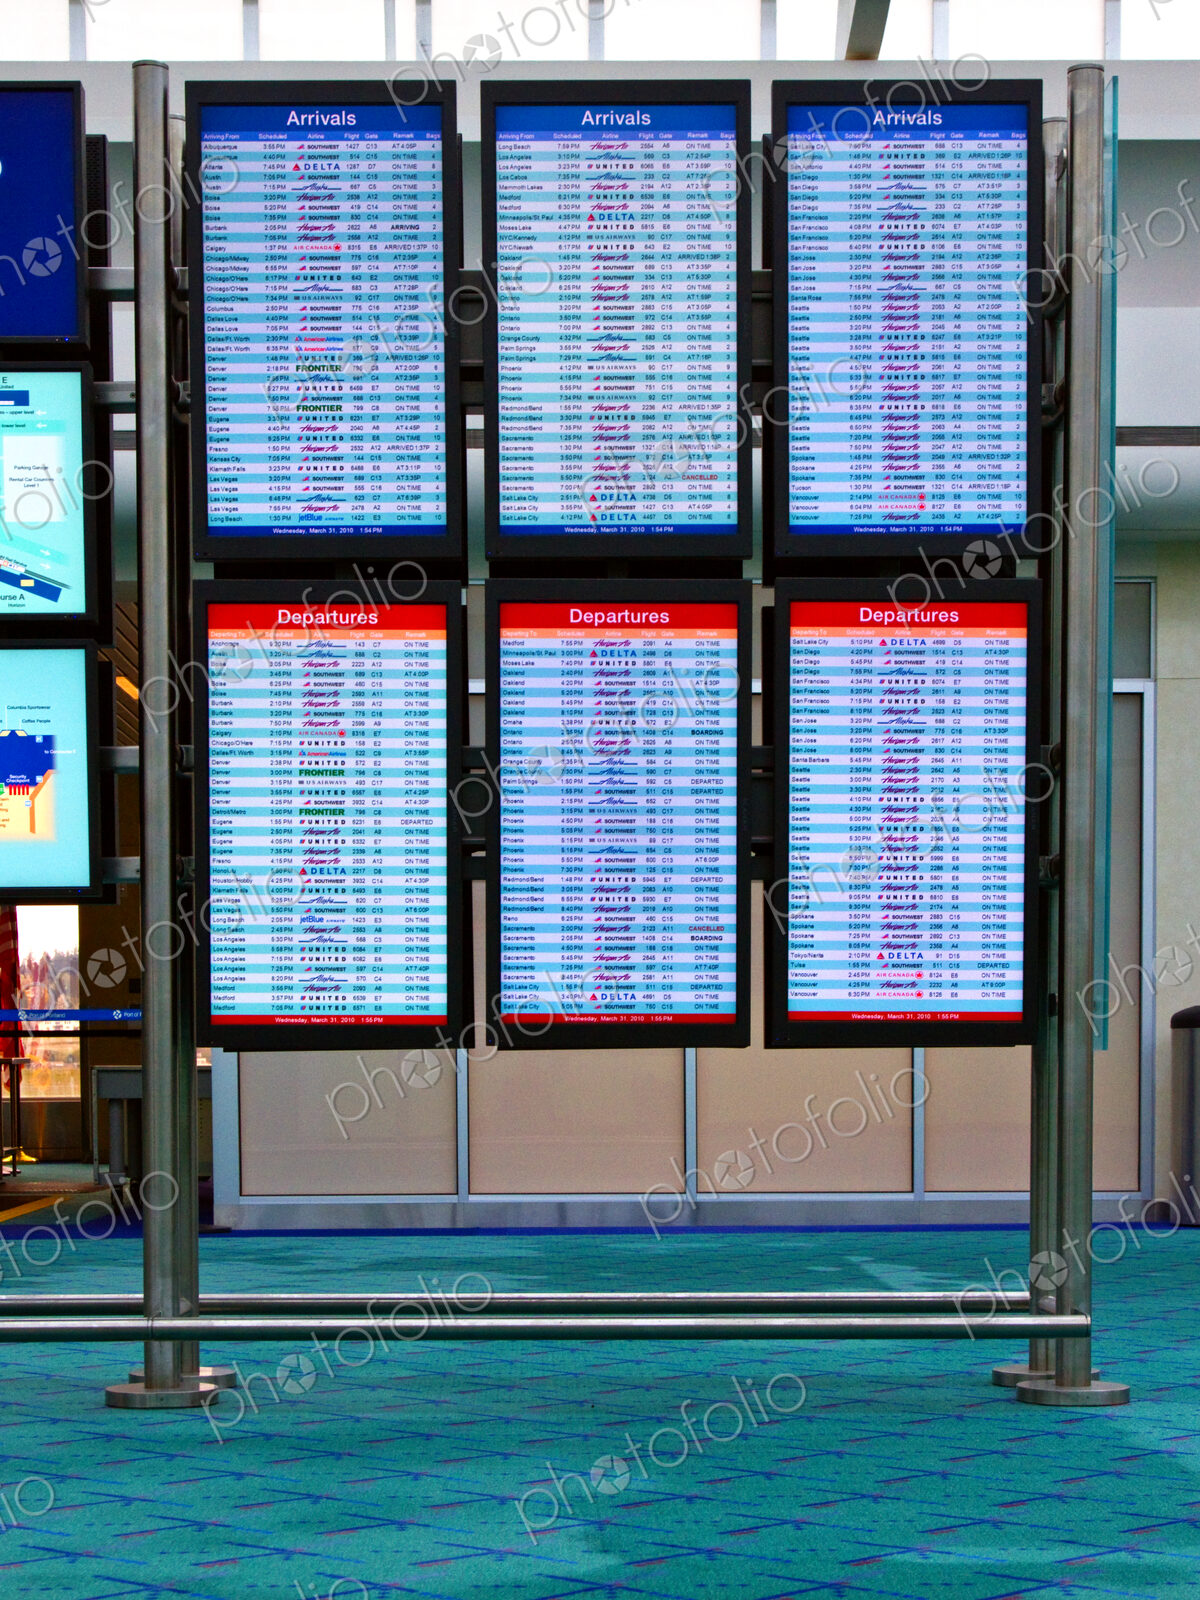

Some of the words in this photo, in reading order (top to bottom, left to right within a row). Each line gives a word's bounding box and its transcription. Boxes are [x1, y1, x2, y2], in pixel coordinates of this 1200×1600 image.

[287, 111, 356, 126] Arrivals
[581, 111, 651, 126] Arrivals
[873, 111, 942, 125] Arrivals
[304, 163, 341, 171] DELTA
[299, 513, 323, 522] jetBlue
[278, 610, 378, 627] Departures
[570, 609, 670, 626] Departures
[859, 608, 959, 625] Departures
[299, 808, 345, 816] FRONTIER
[300, 916, 324, 924] jetBlue
[888, 952, 924, 960] DELTA
